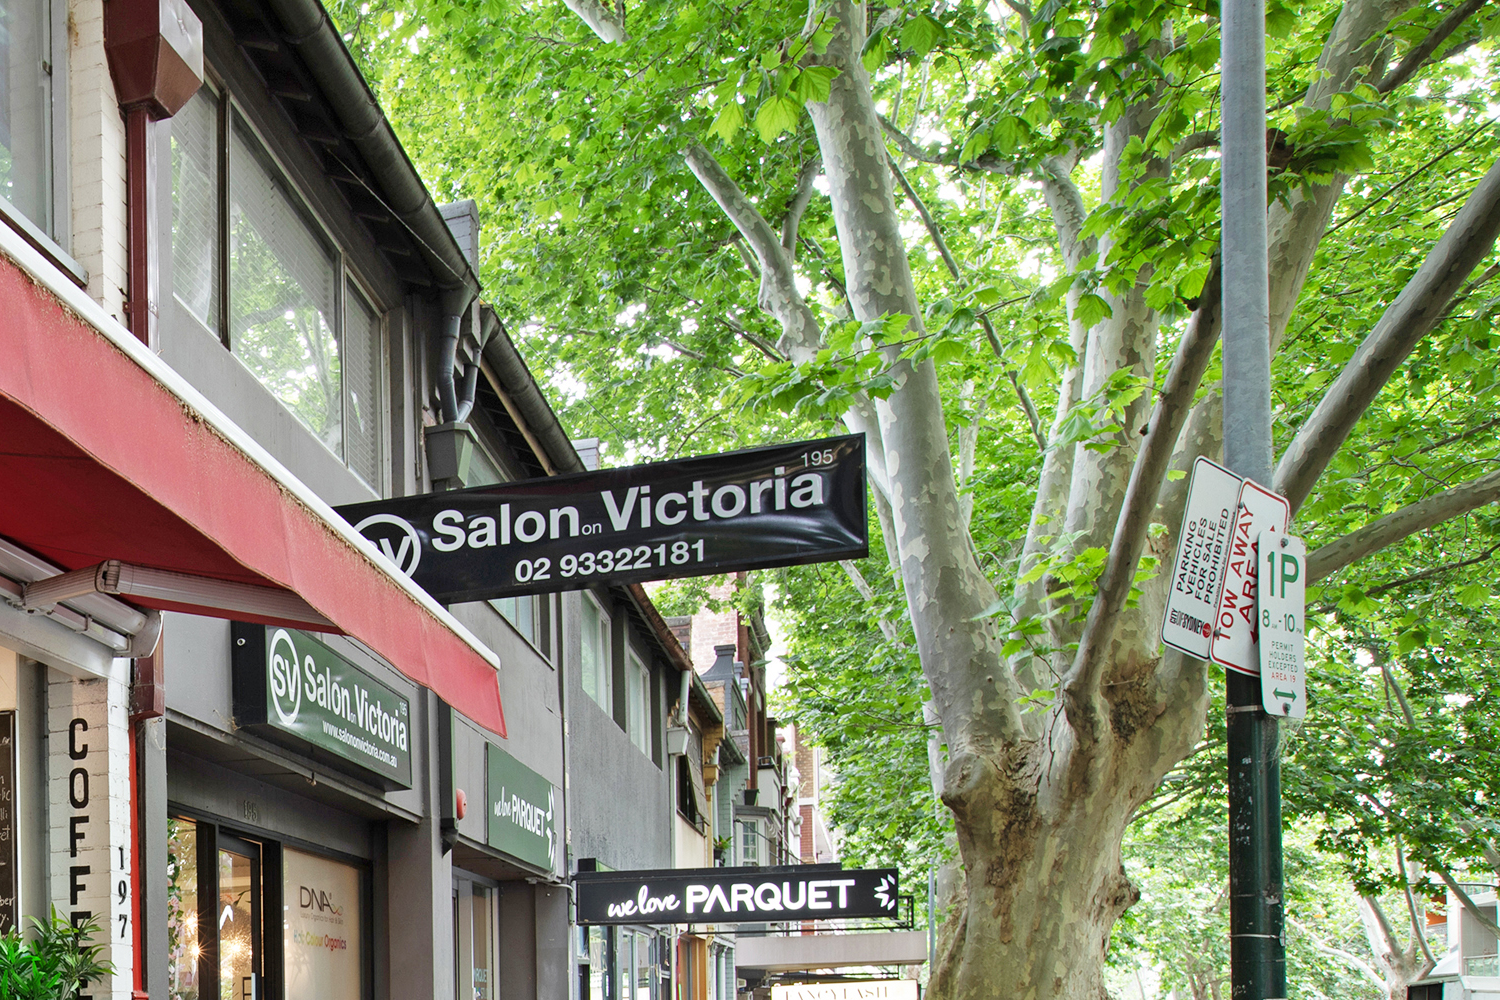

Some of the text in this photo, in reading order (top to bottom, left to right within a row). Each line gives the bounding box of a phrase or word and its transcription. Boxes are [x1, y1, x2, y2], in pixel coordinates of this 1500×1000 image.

[801, 450, 833, 467] 195
[432, 466, 824, 552] Salon on Victoria
[515, 539, 704, 582] 02 93322181
[1176, 521, 1196, 592] PARKING
[1185, 518, 1208, 595] VEHICLES
[1195, 520, 1217, 600] FOR SALE
[1204, 508, 1228, 604] PROHIBITED
[1217, 502, 1254, 640] TOW AWAY
[1267, 551, 1298, 598] 1P
[1268, 660, 1298, 673] EXCEPTED
[1270, 651, 1296, 662] HOLDERS
[1272, 641, 1294, 652] PERMIT
[1271, 672, 1296, 683] AREA 19
[304, 655, 350, 721] Salon
[354, 684, 407, 752] Victoria
[322, 721, 398, 767] www.salononvictoria.com.au
[512, 794, 545, 837] PARQUET
[118, 847, 128, 938] 197
[300, 886, 336, 914] DNA
[608, 879, 855, 918] we love PARQUET
[324, 934, 346, 951] Organics
